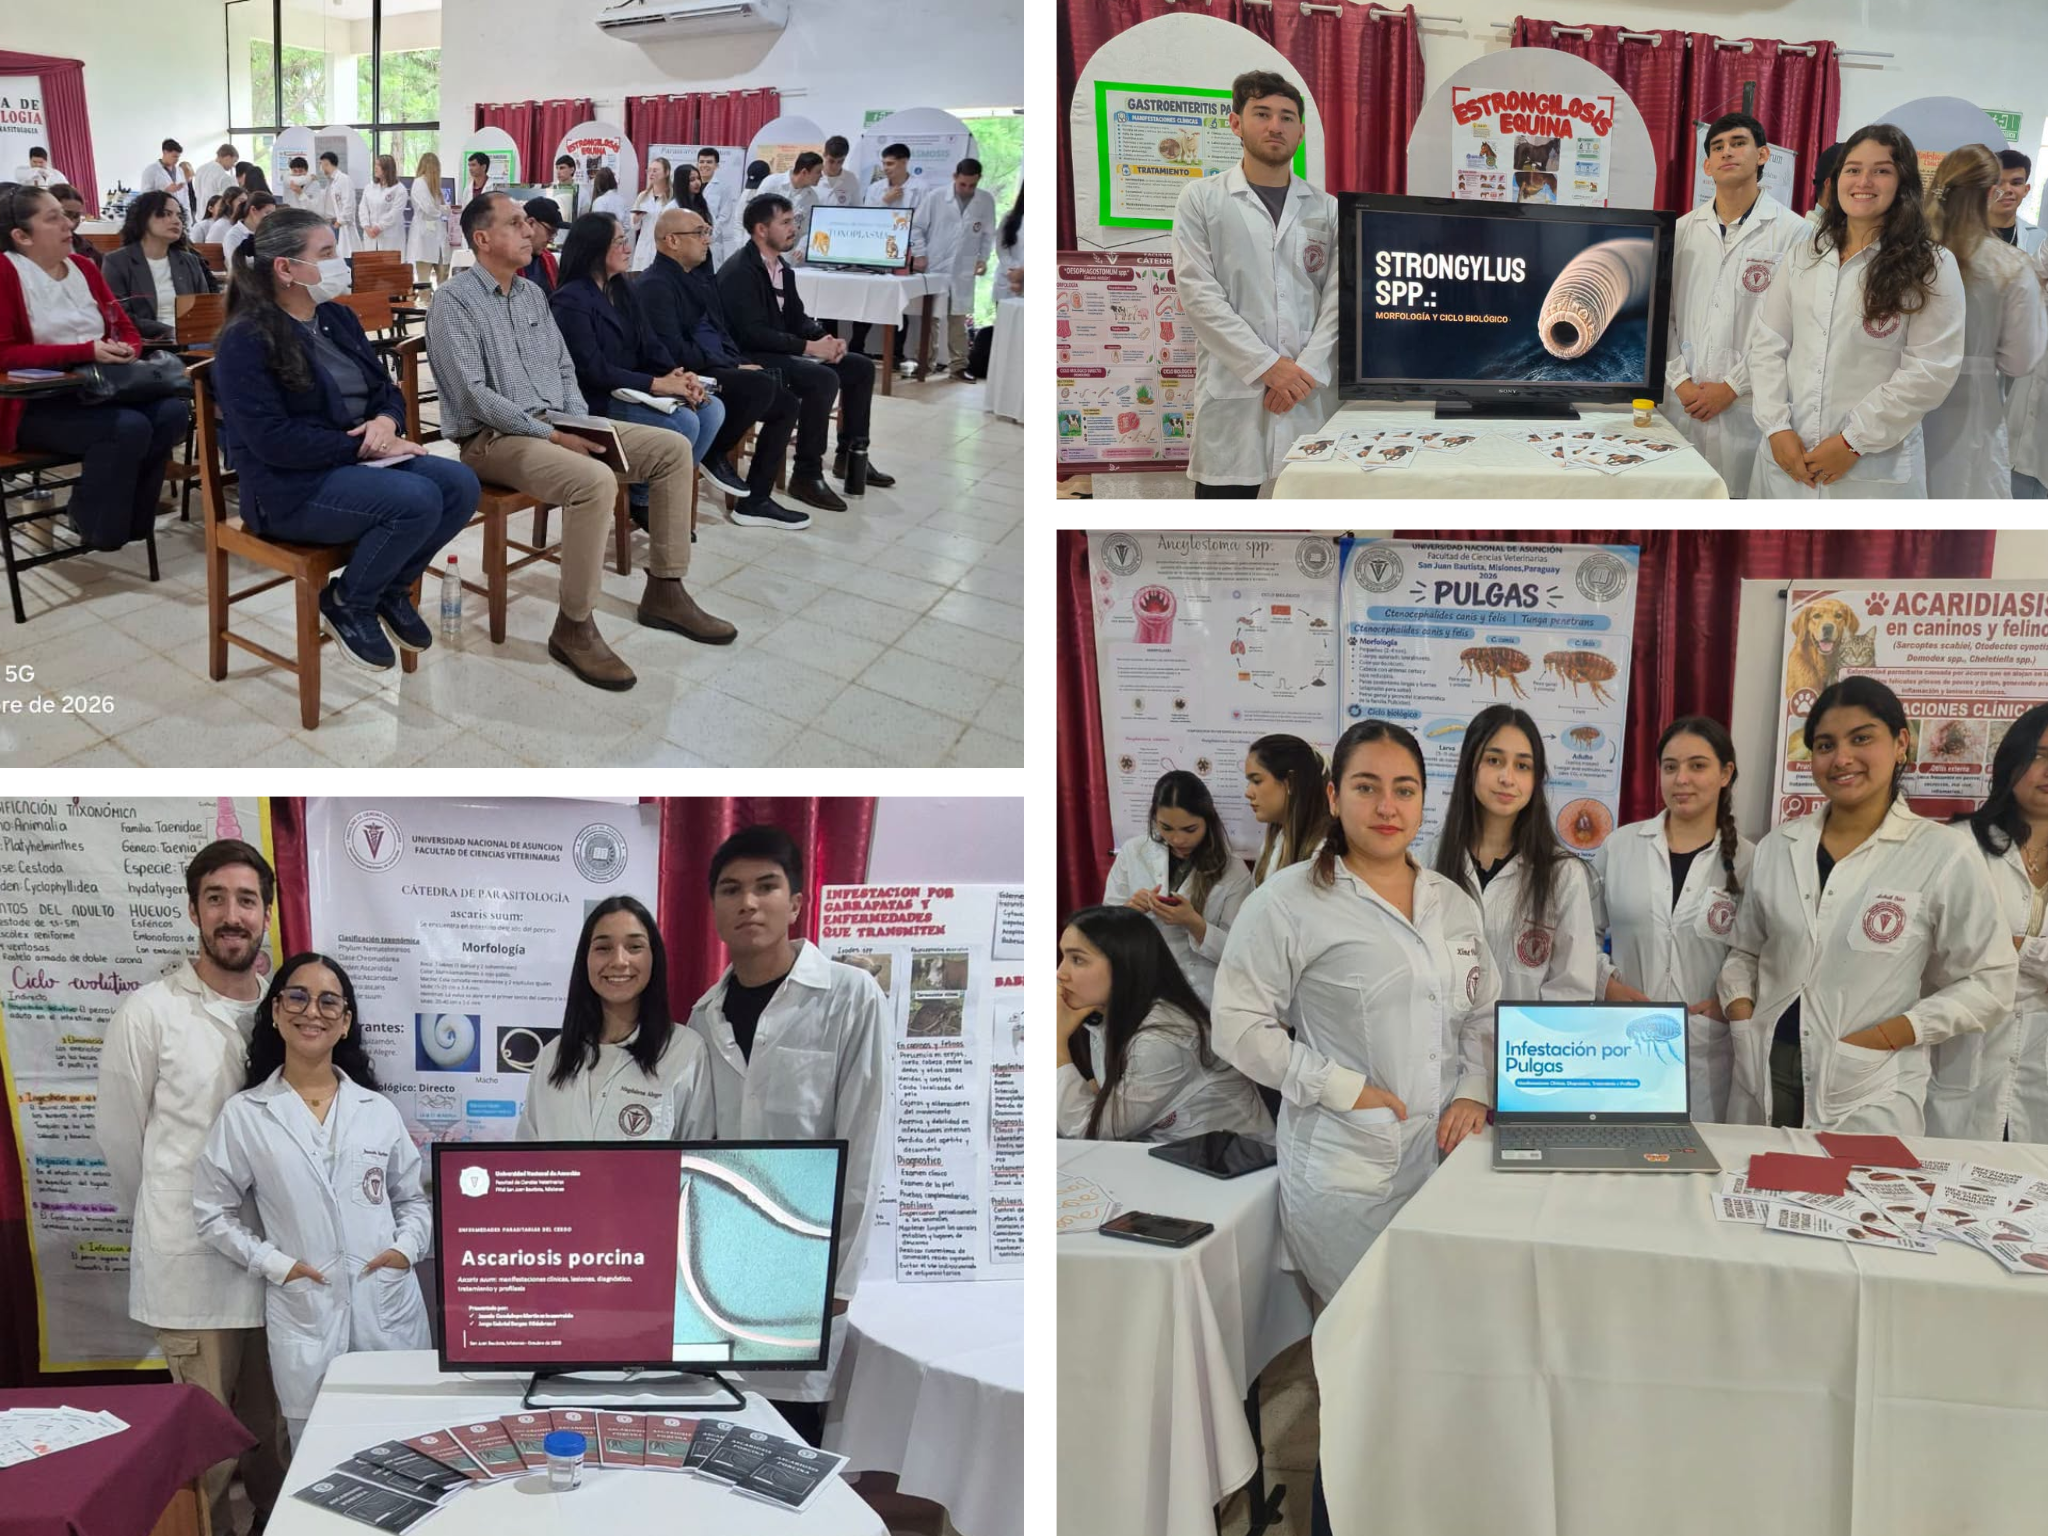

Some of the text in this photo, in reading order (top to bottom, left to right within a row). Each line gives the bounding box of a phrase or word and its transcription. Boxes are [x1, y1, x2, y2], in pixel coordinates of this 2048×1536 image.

[20, 99, 40, 110] DE
[1127, 98, 1218, 115] GASTROENTERITIS
[1452, 90, 1613, 137] ESTRONGILOSIS
[1499, 112, 1574, 139] EQUINA
[1136, 166, 1190, 176] TRATAMIENTO
[1375, 250, 1526, 283] STRONGYLUS
[1375, 280, 1437, 308] SPP.:
[1375, 311, 1509, 324] MORFOLOGÍA Y CICLO BIOLÓGICO
[1158, 532, 1241, 556] Ancylostoma
[1412, 543, 1463, 552] UNIVERSIDAD
[1464, 544, 1505, 553] NACIONAL
[1519, 545, 1563, 554] ASUNCIÓN
[1427, 552, 1548, 563] Facultad de Ciencias Veterinarias
[1418, 561, 1431, 570] San
[1432, 562, 1452, 570] Juan
[1453, 562, 1487, 572] Bautista,
[1479, 572, 1498, 580] 2026
[1434, 580, 1539, 608] PULGAS
[1384, 608, 1594, 627] Ctenocephalides canis y felis Tunga penetrans
[1421, 627, 1444, 636] canis
[1445, 630, 1451, 638] y
[1452, 628, 1469, 638] felis
[1886, 622, 1907, 636] en
[1912, 620, 1982, 637] caninos
[1987, 623, 1998, 641] y
[1359, 637, 1398, 647] Morfología
[1893, 641, 1938, 651] (Sarcoptes
[1367, 707, 1418, 719] Ciclo biológico
[1572, 753, 1593, 761] Adulto
[15, 816, 67, 832] Animalia
[154, 820, 203, 833] Taenidae
[3, 836, 85, 856] Platyhelminthes
[161, 842, 198, 853] Taenia
[411, 835, 563, 852] UNIVERSIDAD NACIONAL DE ASUNCION
[414, 846, 561, 862] FACULTAD DE CIENCIAS VETERINARIAS
[19, 860, 64, 874] Cestoda
[24, 877, 98, 896] Cyclophyllidea
[401, 883, 571, 904] CÁTEDRA DE PARASITOLOGÍA
[826, 887, 955, 900] INFESTACION POR
[39, 903, 115, 917] DEL ADULTO
[129, 904, 182, 919] HUEVOS
[823, 899, 931, 912] GARRAPATAS Y
[450, 909, 524, 922] ascaris suum:
[823, 912, 933, 926] ENFERMEDADES
[131, 918, 173, 929] Esféricos
[822, 924, 946, 939] QUE TRANSMITEN
[338, 934, 380, 945] Clasificación
[7, 942, 50, 952] ventosas
[462, 941, 526, 957] Morfología
[35, 953, 66, 963] armado
[69, 953, 80, 963] de
[115, 956, 143, 964] corona
[12, 965, 143, 996] Ciclo evolutivo
[1506, 1040, 1632, 1060] Infestación por
[1506, 1057, 1564, 1077] Pulgas
[475, 1075, 499, 1085] Macho
[419, 1082, 455, 1094] Directo
[897, 1154, 942, 1168] Diagnostico
[461, 1248, 645, 1269] Ascariosis porcina
